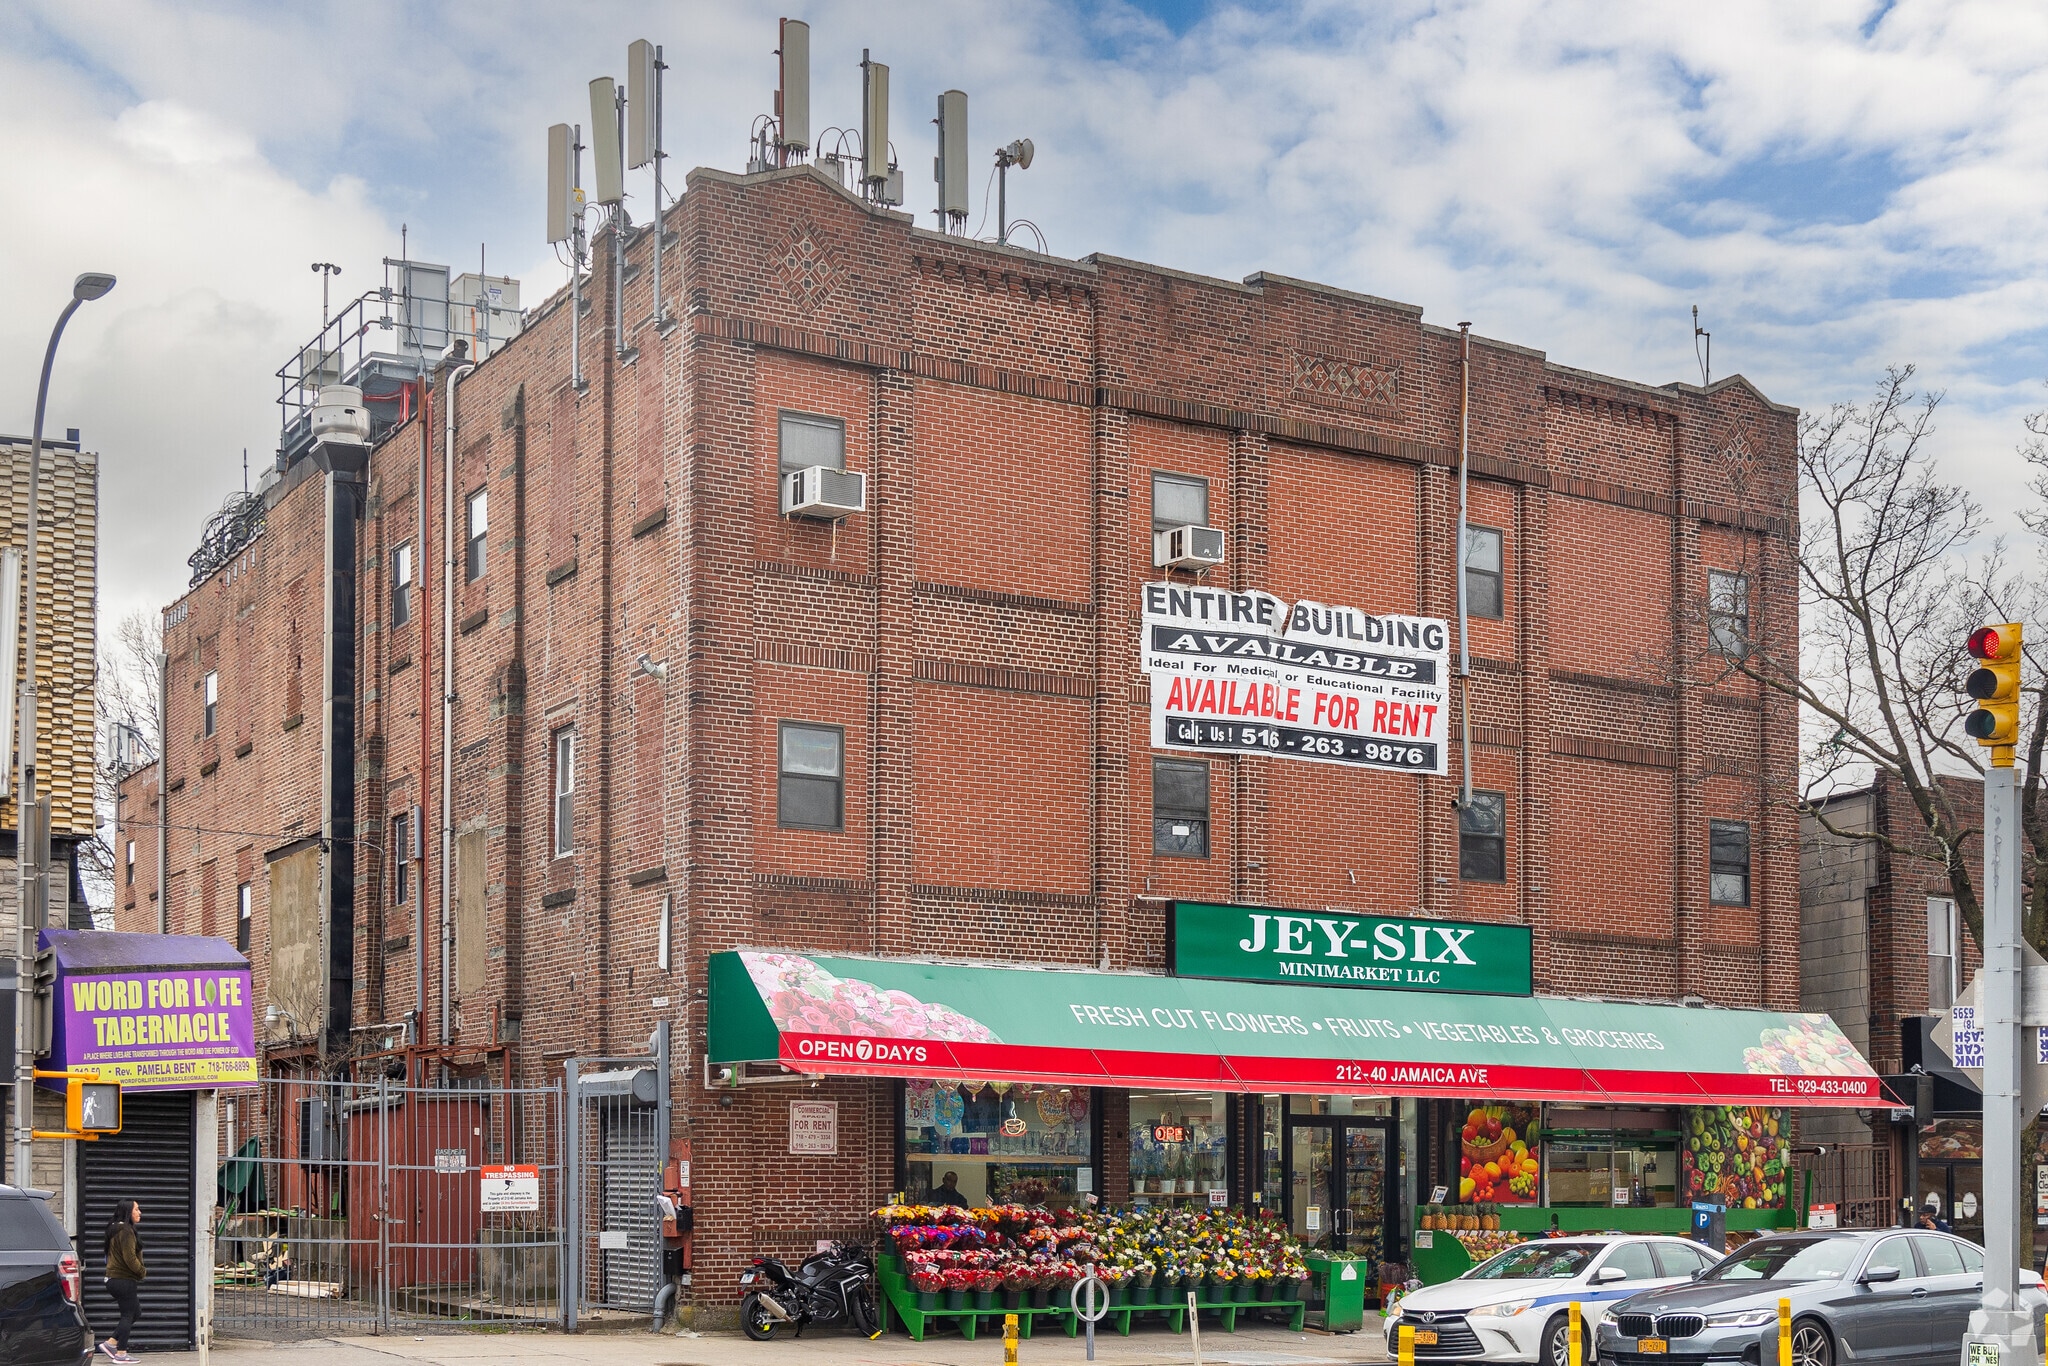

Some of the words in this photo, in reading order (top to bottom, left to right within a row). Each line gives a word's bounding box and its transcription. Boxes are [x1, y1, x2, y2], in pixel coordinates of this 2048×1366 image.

[1146, 585, 1276, 626] ENTIRE
[1291, 604, 1444, 650] BUILDING
[1168, 634, 1416, 678] AVAILABLE
[1148, 657, 1184, 670] Ideal
[1194, 662, 1217, 672] For
[1227, 664, 1278, 678] Medical
[1285, 673, 1298, 682] or
[1306, 674, 1382, 694] Educational
[1392, 687, 1442, 702] Facility
[1165, 676, 1300, 722] AVAILABLE
[1313, 692, 1360, 730] FOR
[1372, 700, 1438, 738] RENT
[1239, 914, 1476, 965] JEY-SIX
[1279, 962, 1402, 982] MINIMARKET
[1406, 970, 1440, 984] LLC
[72, 980, 147, 1012] WORD
[148, 978, 190, 1008] FOR
[1953, 1008, 1974, 1019] 6395
[93, 1012, 231, 1046] TABERNACLE
[1069, 1004, 1150, 1028] FRESH
[1151, 1008, 1198, 1030] CUT
[1200, 1010, 1309, 1036] FLOWERS
[1324, 1017, 1401, 1040] FRUITS
[1414, 1020, 1540, 1045] VEGETABLES
[1541, 1026, 1562, 1046] &
[1561, 1028, 1665, 1050] GROCERIES
[798, 1040, 853, 1058] OPEN
[876, 1044, 927, 1062] DAYS
[1955, 1056, 1984, 1066] UNK
[115, 1067, 132, 1076] Rev.
[137, 1064, 171, 1076] PAMELA
[174, 1062, 196, 1074] BENT
[1390, 1068, 1454, 1083] JAMAICA
[1459, 1070, 1488, 1083] AVE
[1769, 1079, 1794, 1092] TEL:
[1798, 1080, 1867, 1094] 929-433-0400
[795, 1120, 809, 1130] FOR
[813, 1121, 831, 1130] RENT
[1700, 1214, 1707, 1226] P
[1970, 1346, 1982, 1355] WE
[1983, 1347, 1997, 1356] BUY
[1970, 1356, 1997, 1364] iPHNES
